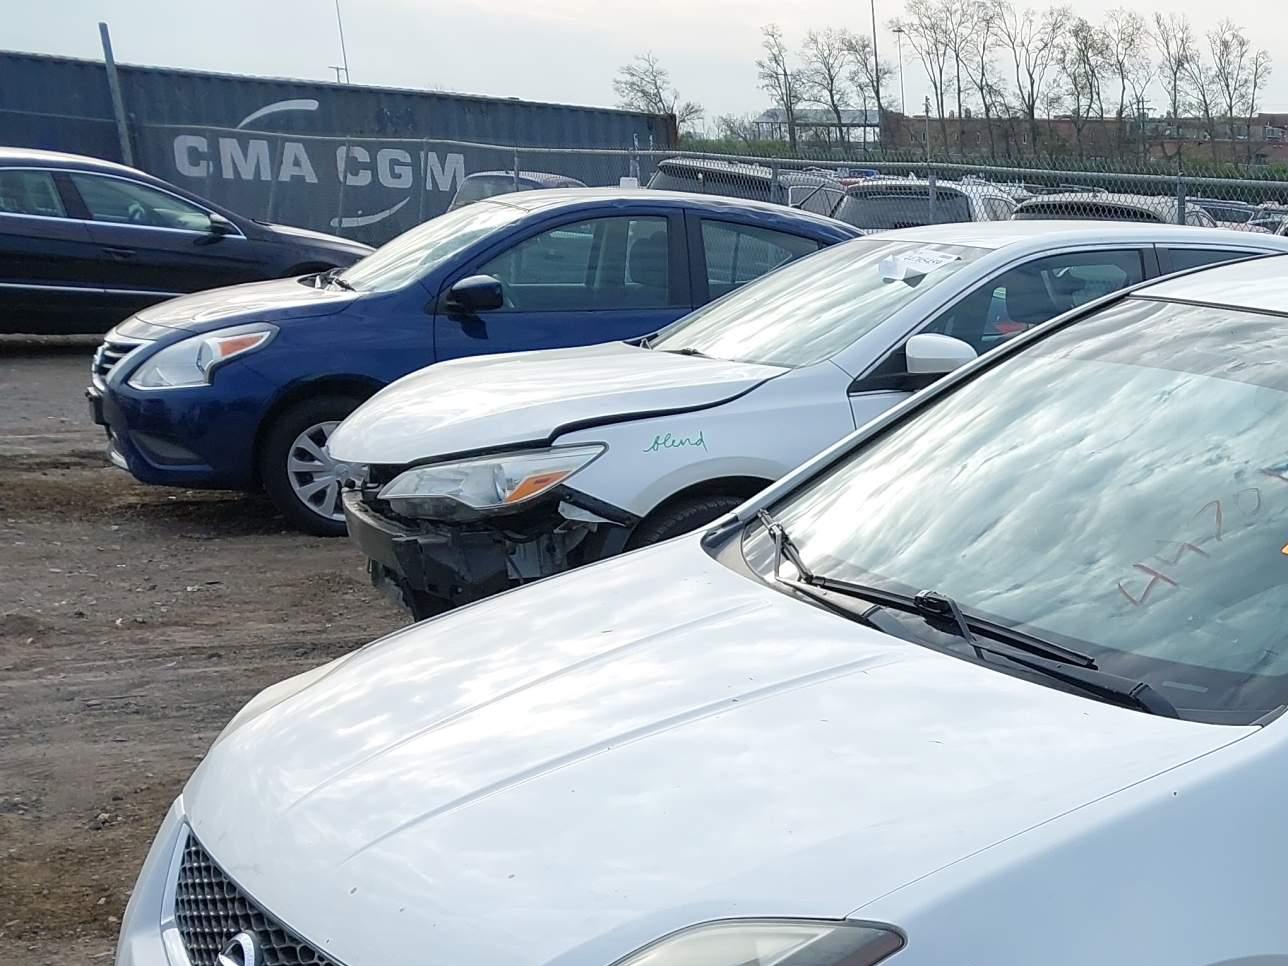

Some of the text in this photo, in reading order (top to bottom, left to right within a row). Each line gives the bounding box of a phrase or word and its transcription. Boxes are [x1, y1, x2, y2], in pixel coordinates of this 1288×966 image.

[173, 134, 465, 192] CMA CGM
[642, 429, 708, 453] blend
